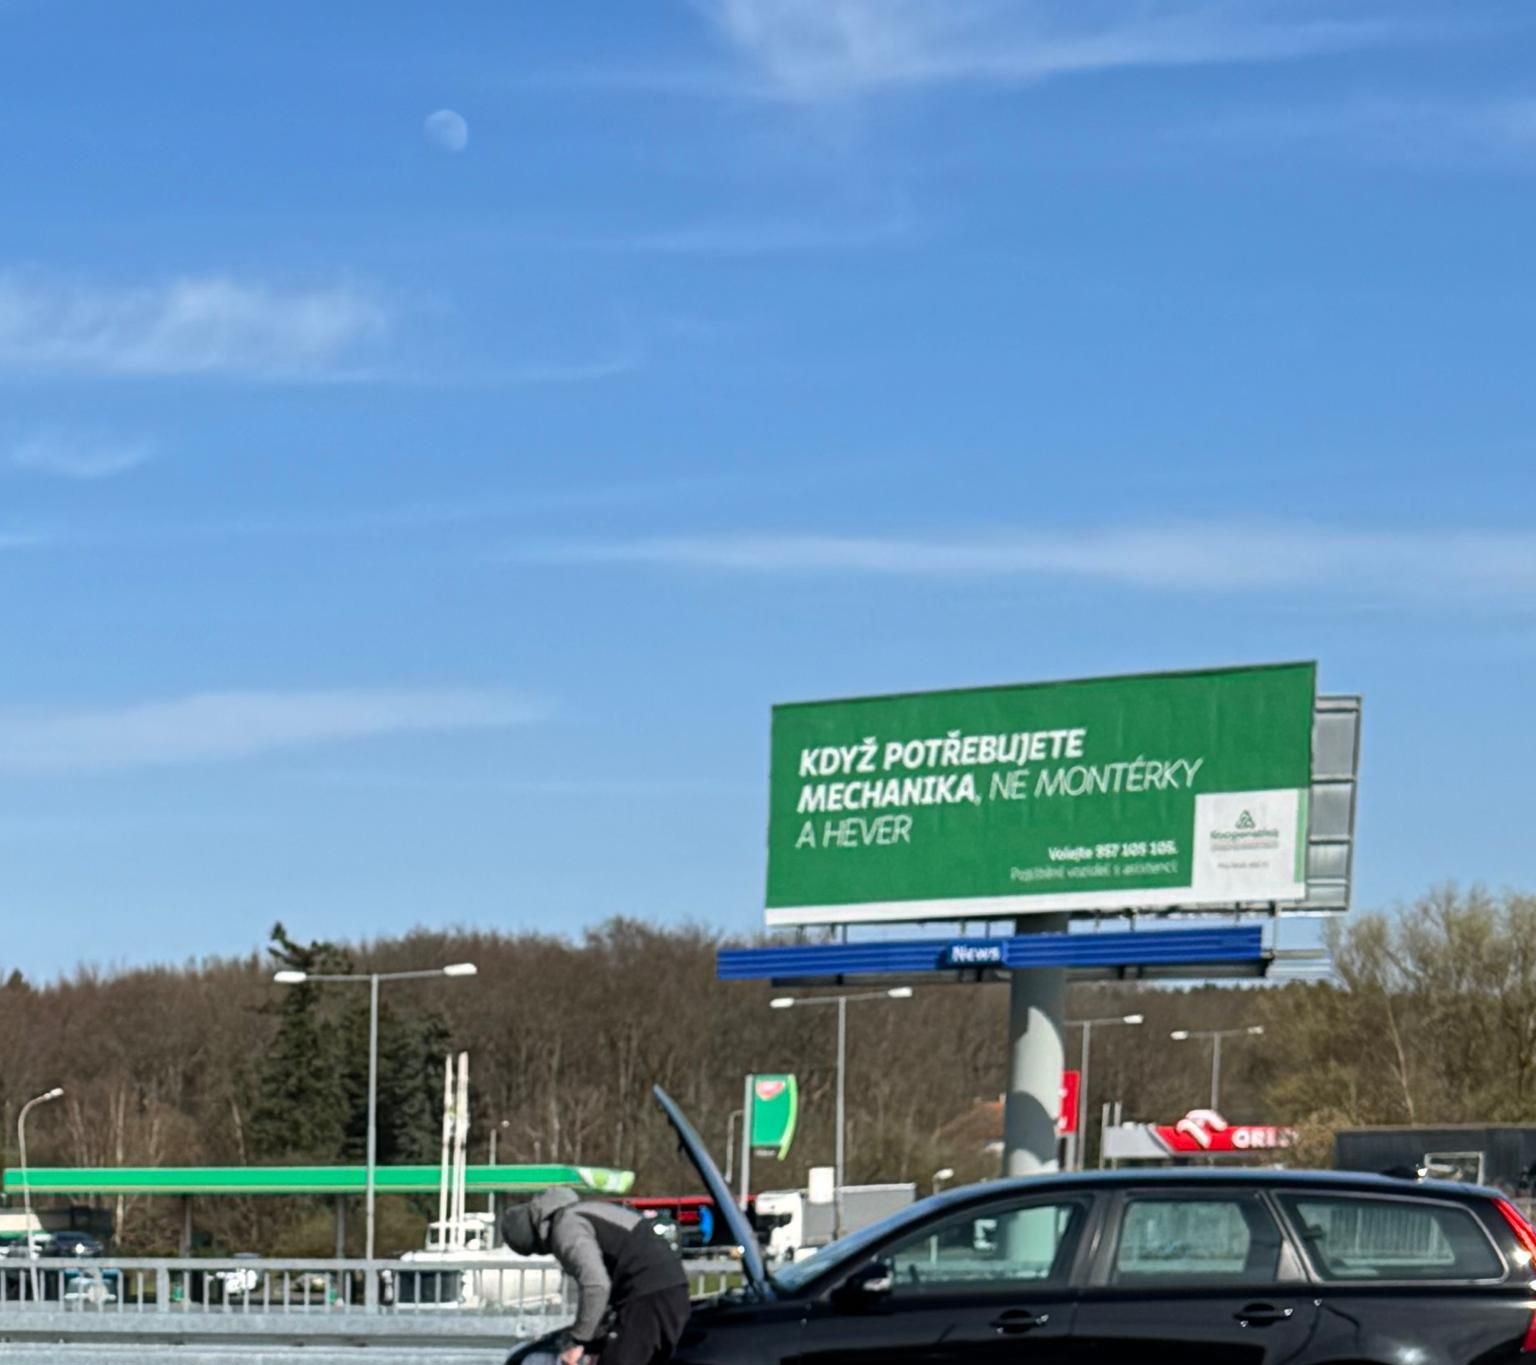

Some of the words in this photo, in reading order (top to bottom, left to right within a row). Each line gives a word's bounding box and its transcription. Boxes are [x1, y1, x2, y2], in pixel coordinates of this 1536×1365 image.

[799, 736, 879, 777] KDYŽ
[883, 728, 1087, 771] POTŘEBUJETE
[797, 772, 981, 814] MECHANIKA,
[988, 769, 1030, 801] NE
[1033, 754, 1204, 799] MONTÉRKY
[795, 820, 816, 849] A
[822, 814, 913, 848] HEVER
[952, 944, 1001, 963] News
